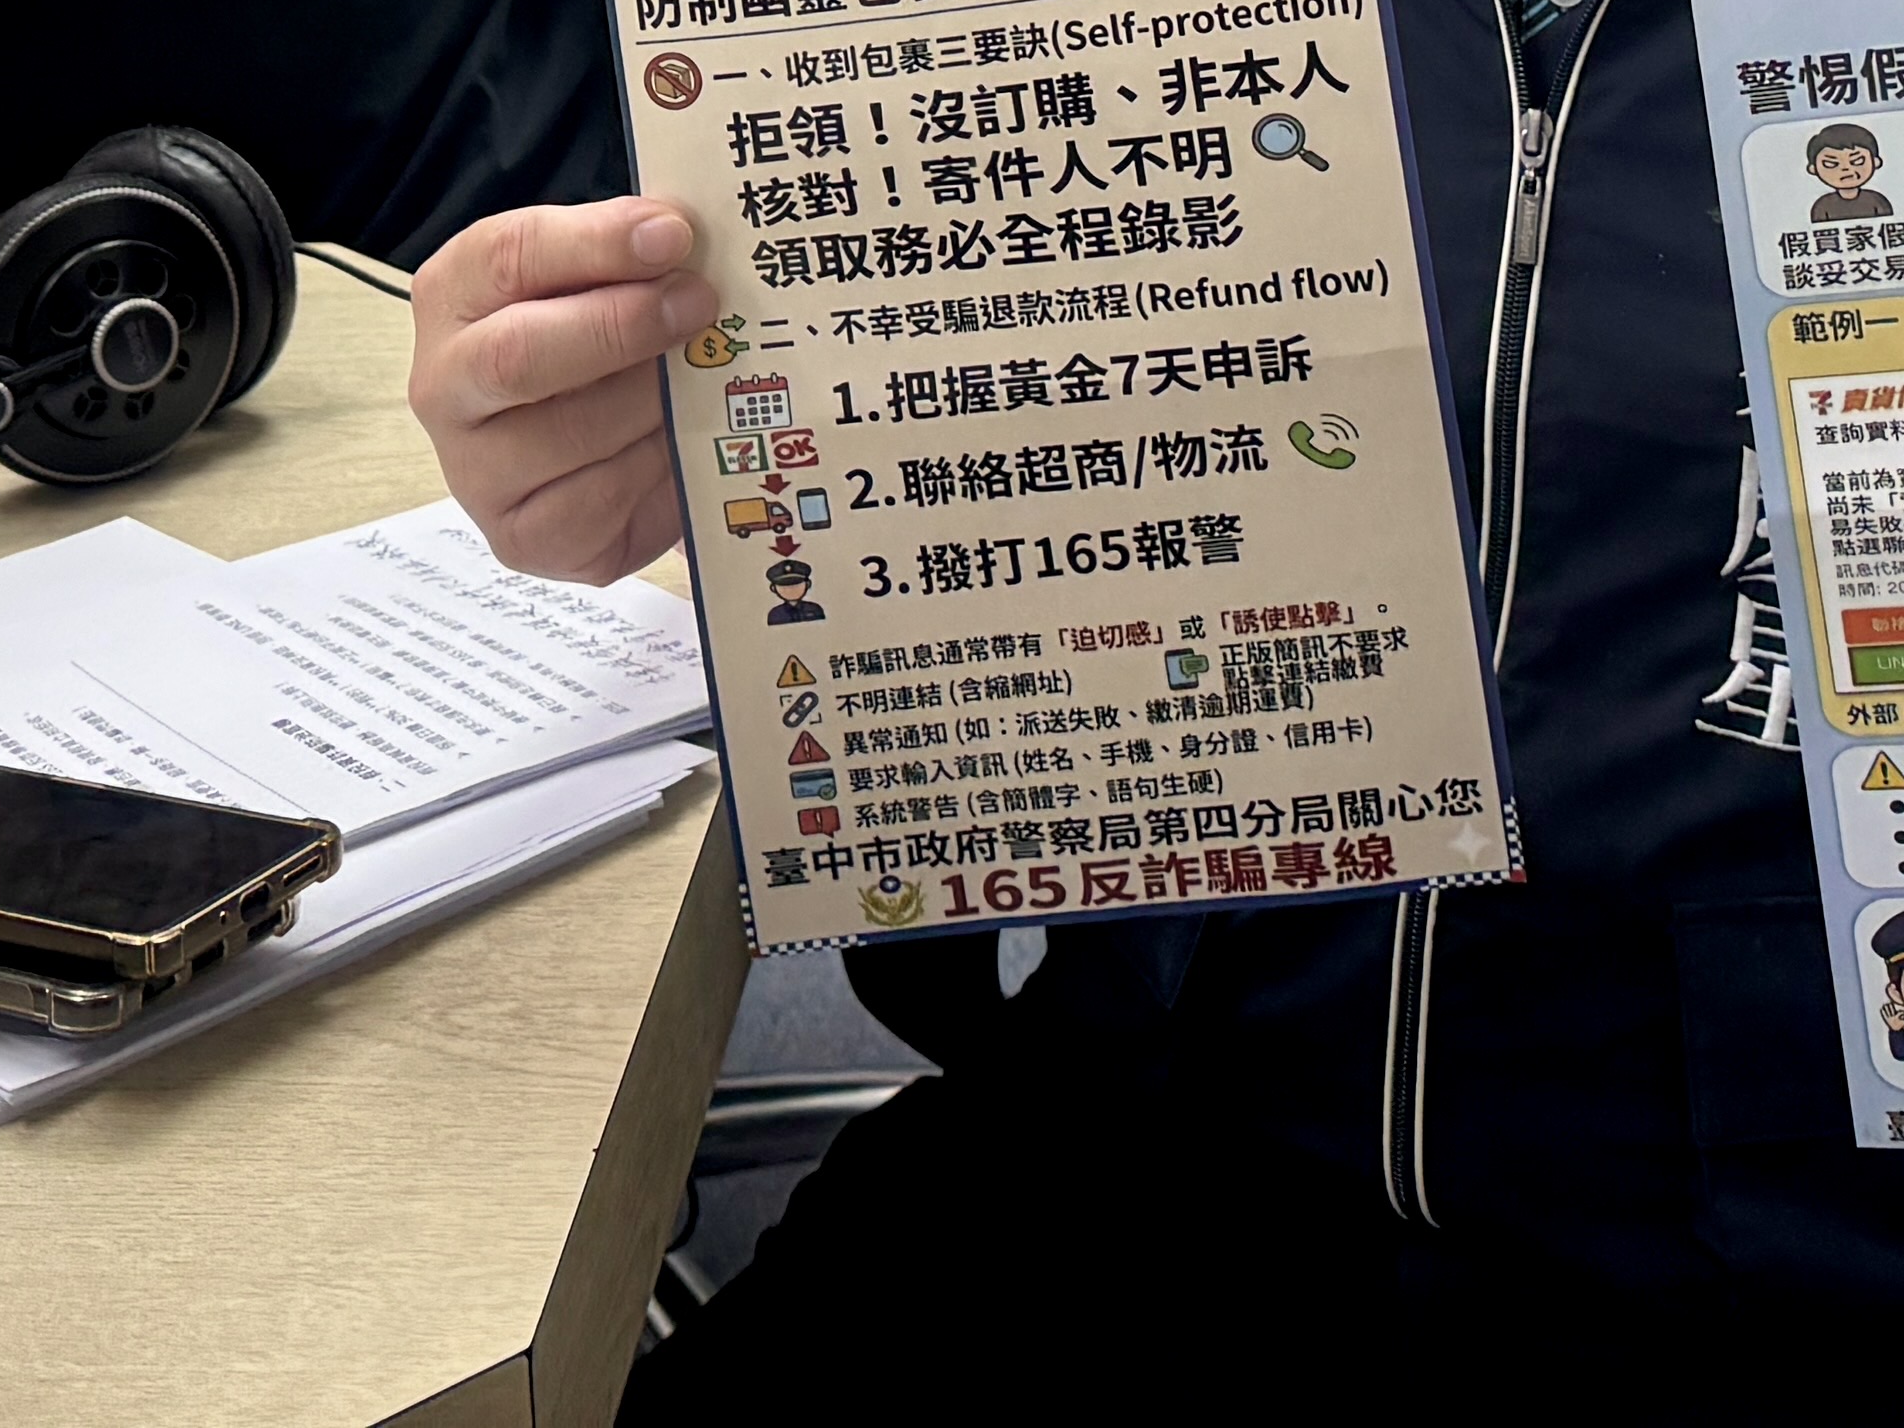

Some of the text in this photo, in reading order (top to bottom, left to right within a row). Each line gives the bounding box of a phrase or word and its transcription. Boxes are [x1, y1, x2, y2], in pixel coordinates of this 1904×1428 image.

[750, 193, 1243, 288] 領取務必全程錄影
[764, 777, 1484, 890] 臺中市政府警察局第四分局關心您
